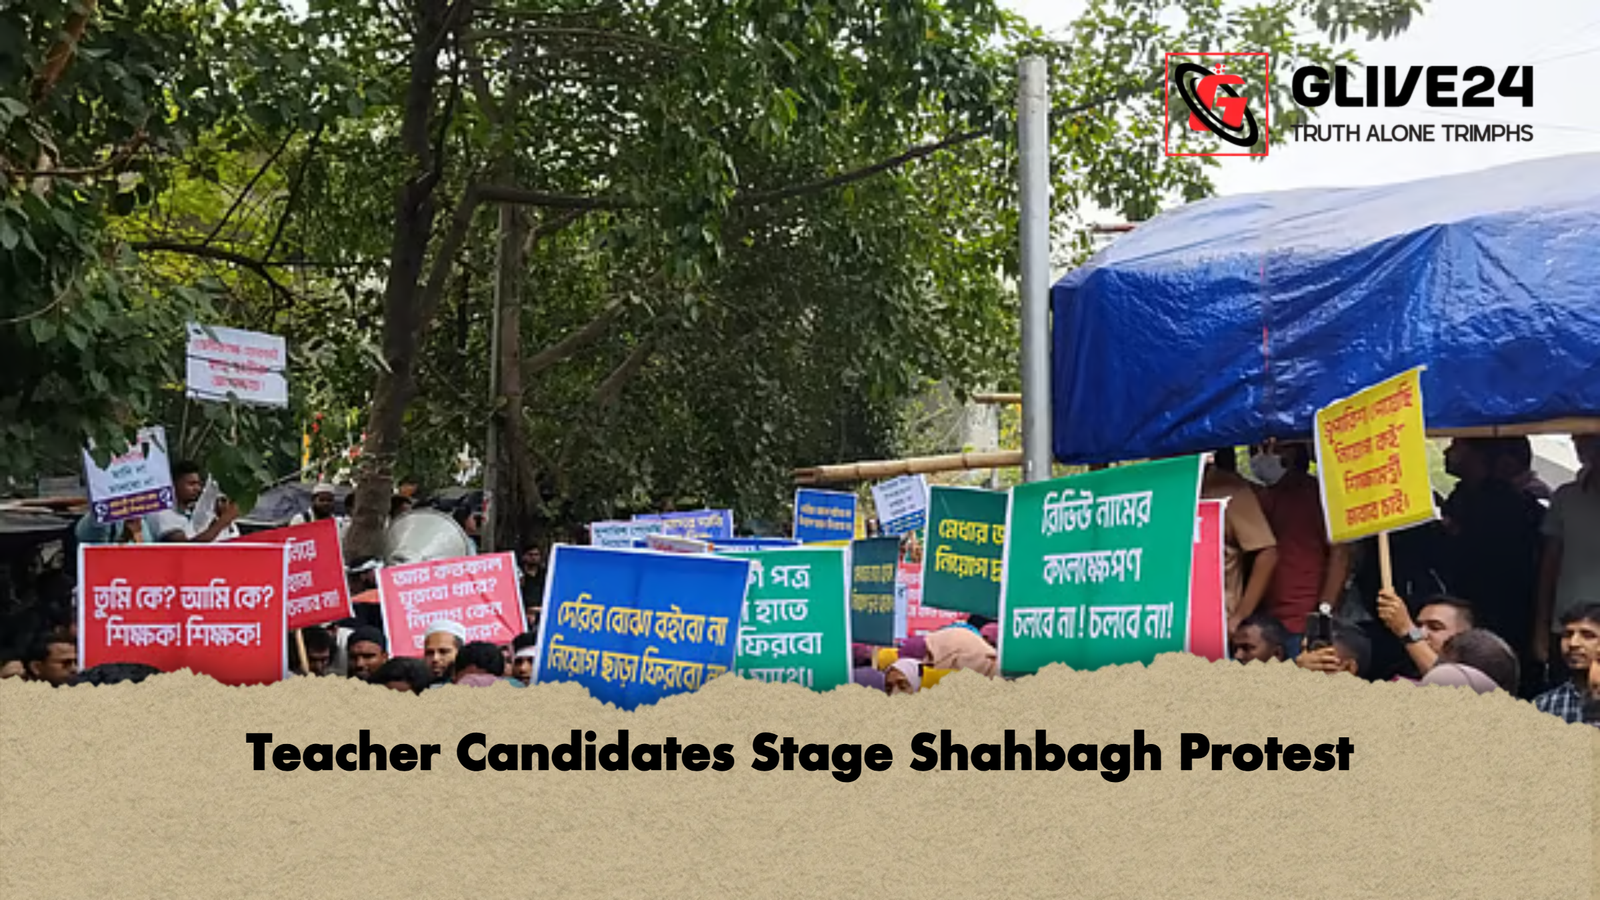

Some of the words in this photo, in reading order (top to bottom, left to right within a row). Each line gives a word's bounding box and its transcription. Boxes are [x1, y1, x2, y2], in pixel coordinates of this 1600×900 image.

[1041, 488, 1094, 536] রিভিউ
[1095, 490, 1153, 528] নামের
[939, 518, 989, 546] মেধার
[771, 565, 811, 588] পত্র
[935, 544, 989, 579] নিয়োগ
[1042, 547, 1143, 585] কালক্ষেপণ
[93, 578, 132, 619] তুমি
[136, 585, 176, 610] কে?
[180, 578, 231, 610] আমি
[234, 585, 275, 610] কে?
[754, 599, 809, 624] হাতে
[106, 615, 182, 647] শিক্ষক!
[186, 615, 262, 647] শিক্ষক!
[558, 592, 606, 633] দেরির
[606, 606, 654, 637] বোঝা
[655, 603, 706, 643] বইবো
[707, 616, 729, 646] না
[1012, 606, 1055, 639] চলবে
[1089, 604, 1142, 639] চলবে
[547, 633, 600, 677] নিয়োগ
[601, 650, 640, 687] ছাড়া
[640, 646, 704, 690] ফিরবো
